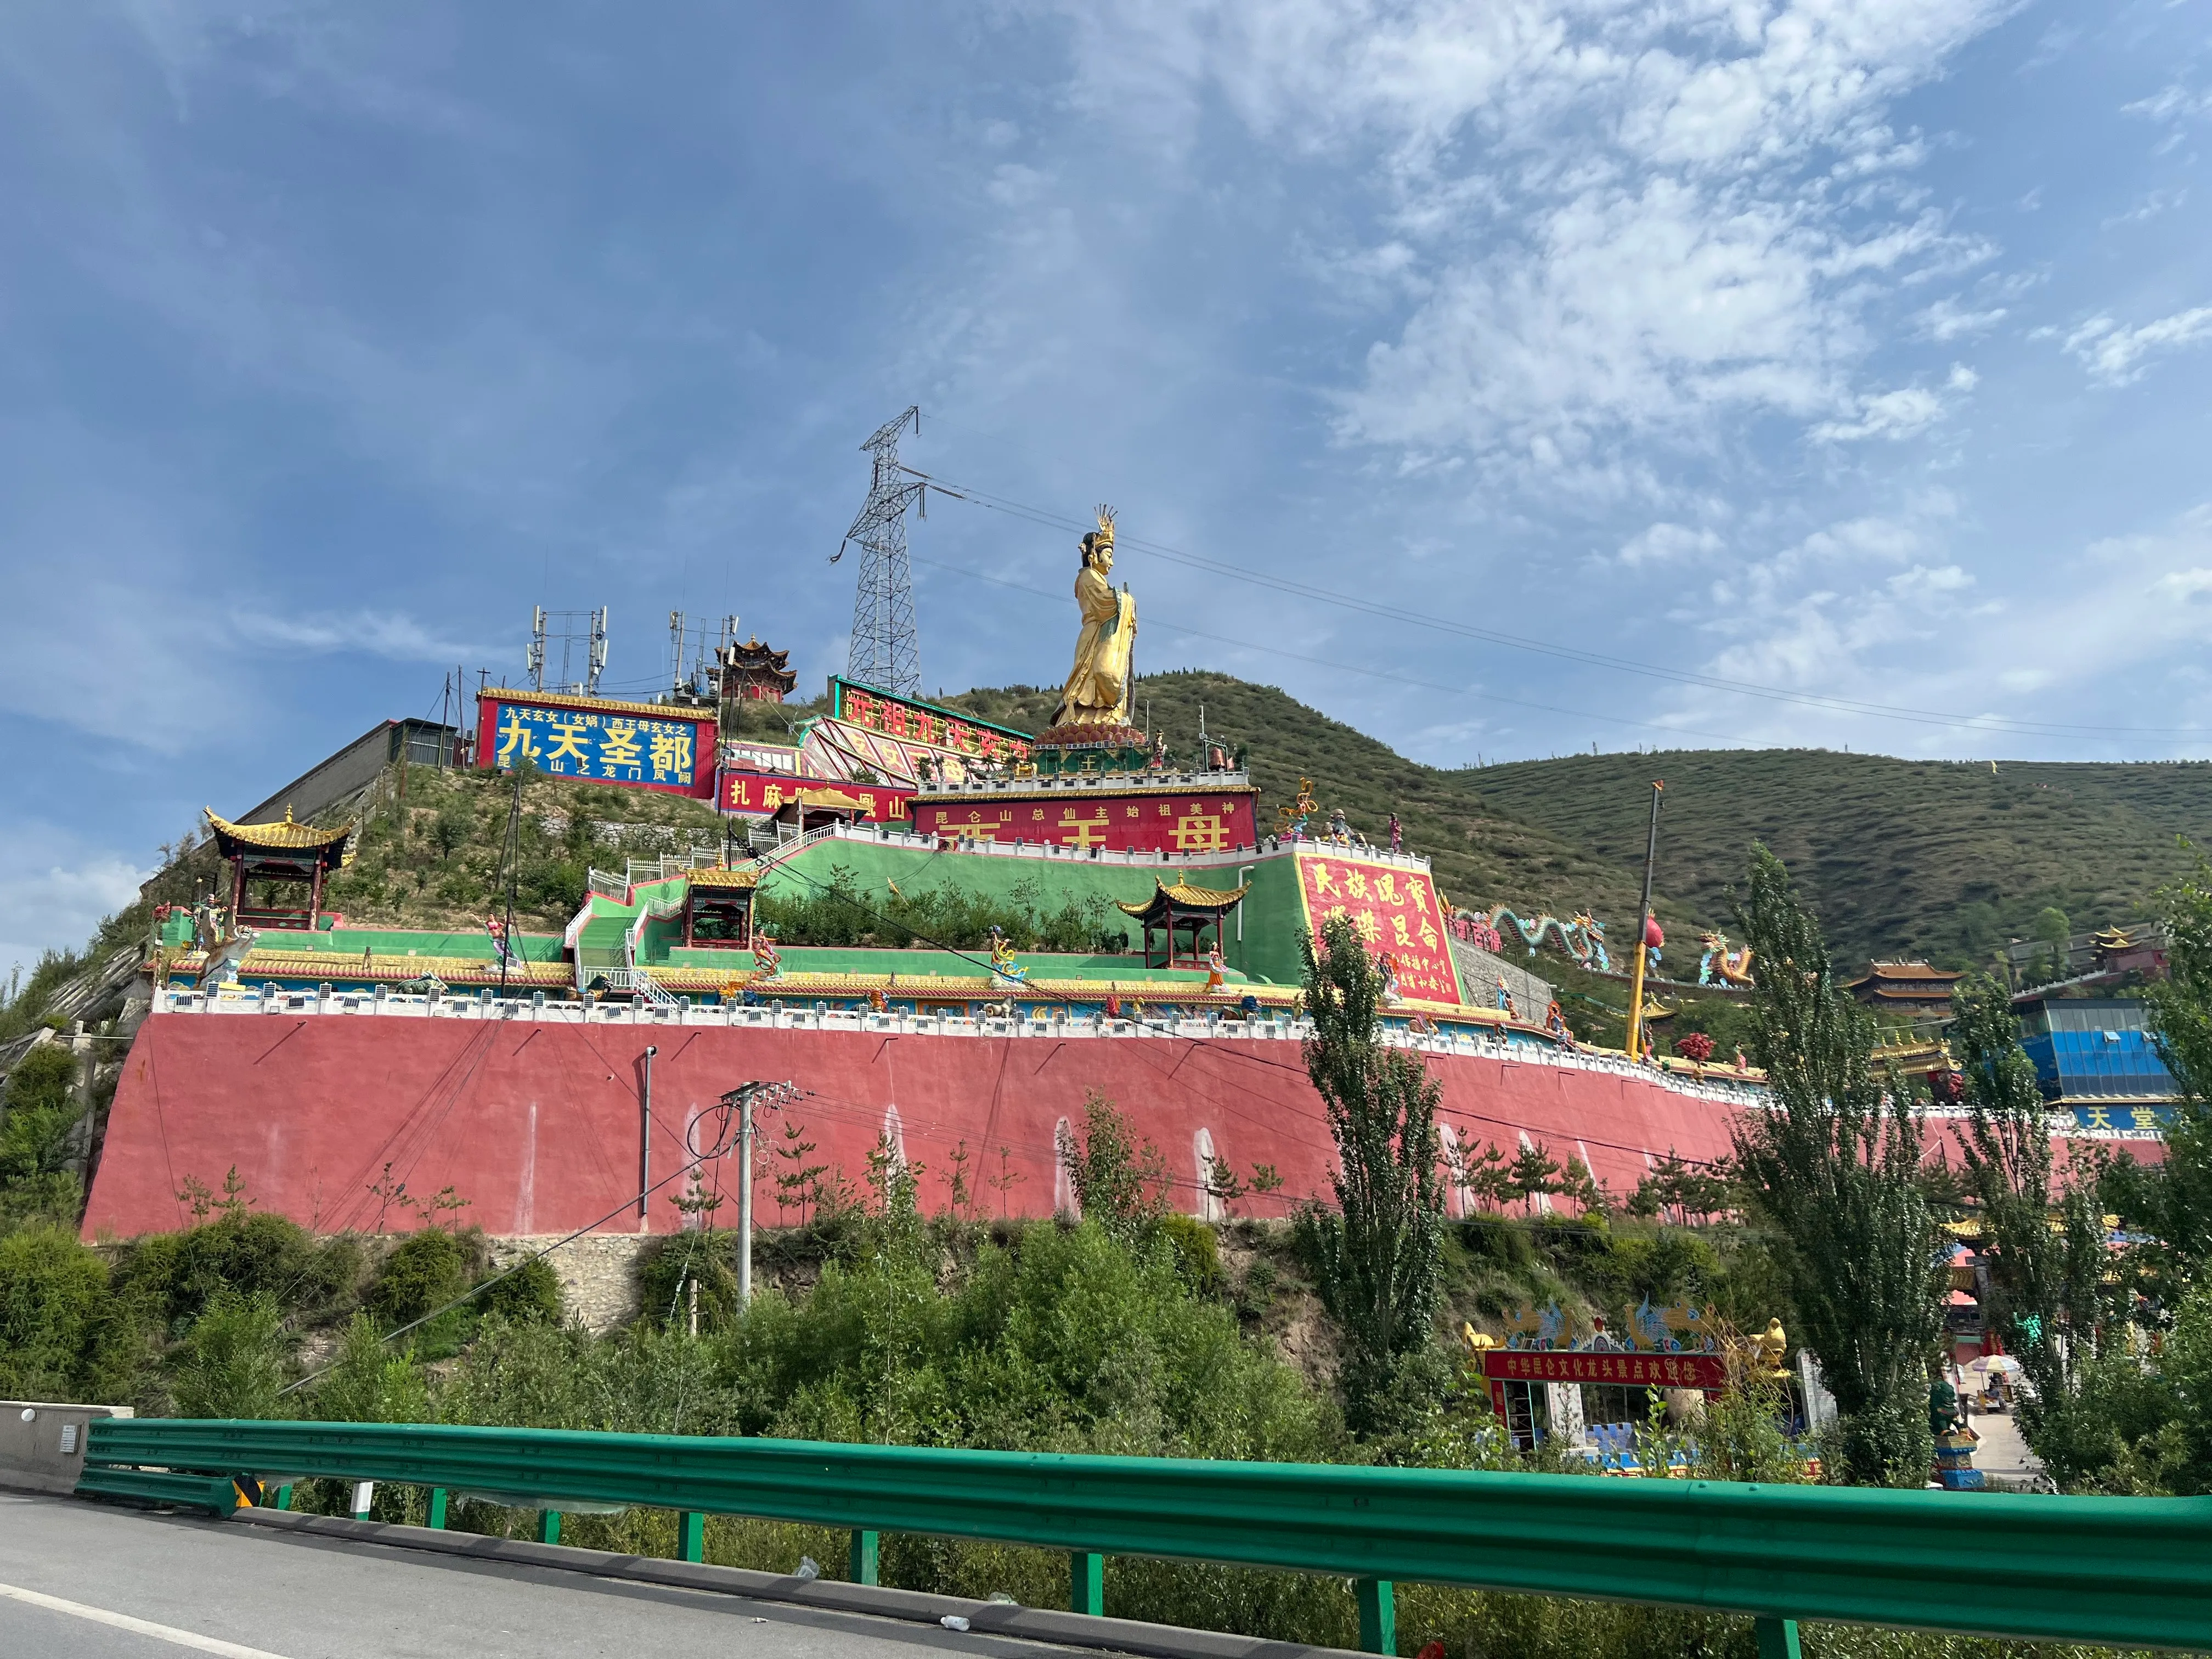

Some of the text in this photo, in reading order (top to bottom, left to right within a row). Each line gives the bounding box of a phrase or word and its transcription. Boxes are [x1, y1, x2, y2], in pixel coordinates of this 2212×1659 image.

[496, 719, 691, 774] 九天圣都
[496, 754, 691, 785] 昆山之龙门凤阙
[731, 780, 905, 820] 扎麻凰山
[935, 801, 1234, 824] 昆仑山总仙主始祖美神
[2087, 1105, 2158, 1130] 天堂
